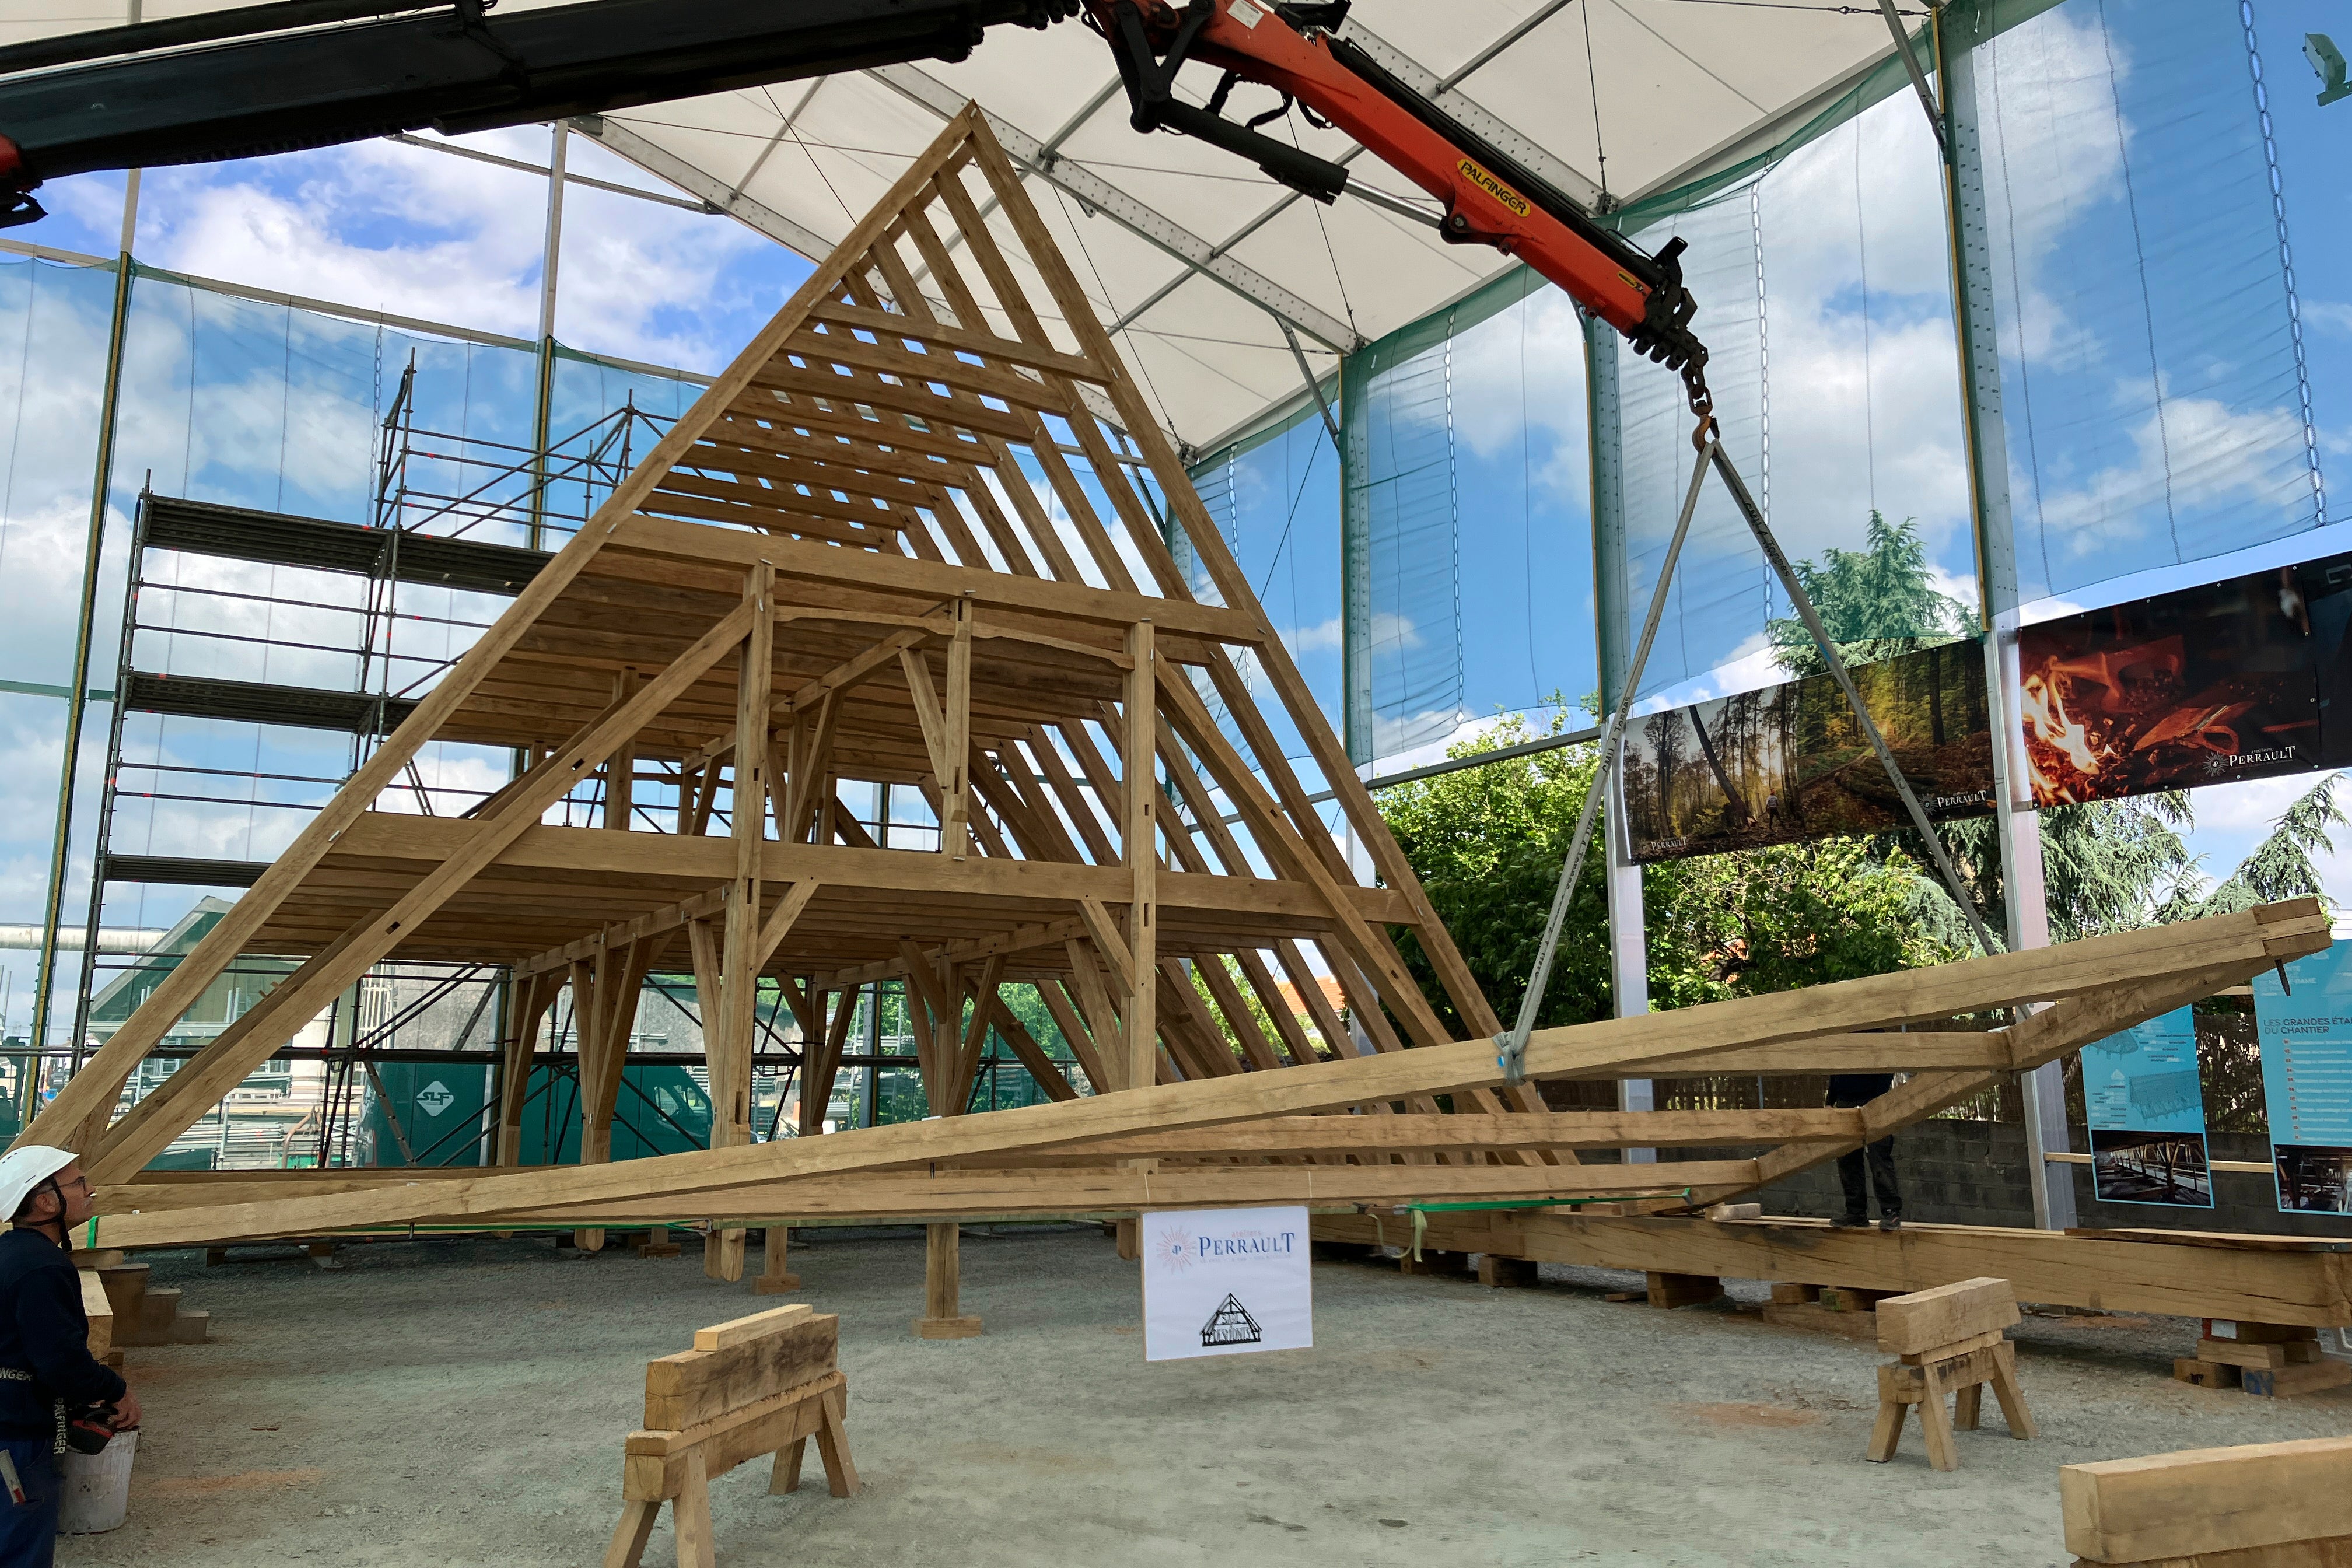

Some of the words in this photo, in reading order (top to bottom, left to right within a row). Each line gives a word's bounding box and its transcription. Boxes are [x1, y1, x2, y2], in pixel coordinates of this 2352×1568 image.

[1461, 161, 1527, 214] PALFINGER
[2283, 1017, 2330, 1026] GRANDES
[2332, 1016, 2352, 1025] ÉTA
[2281, 1026, 2329, 1034] CHANTIER
[416, 1091, 450, 1105] SLF
